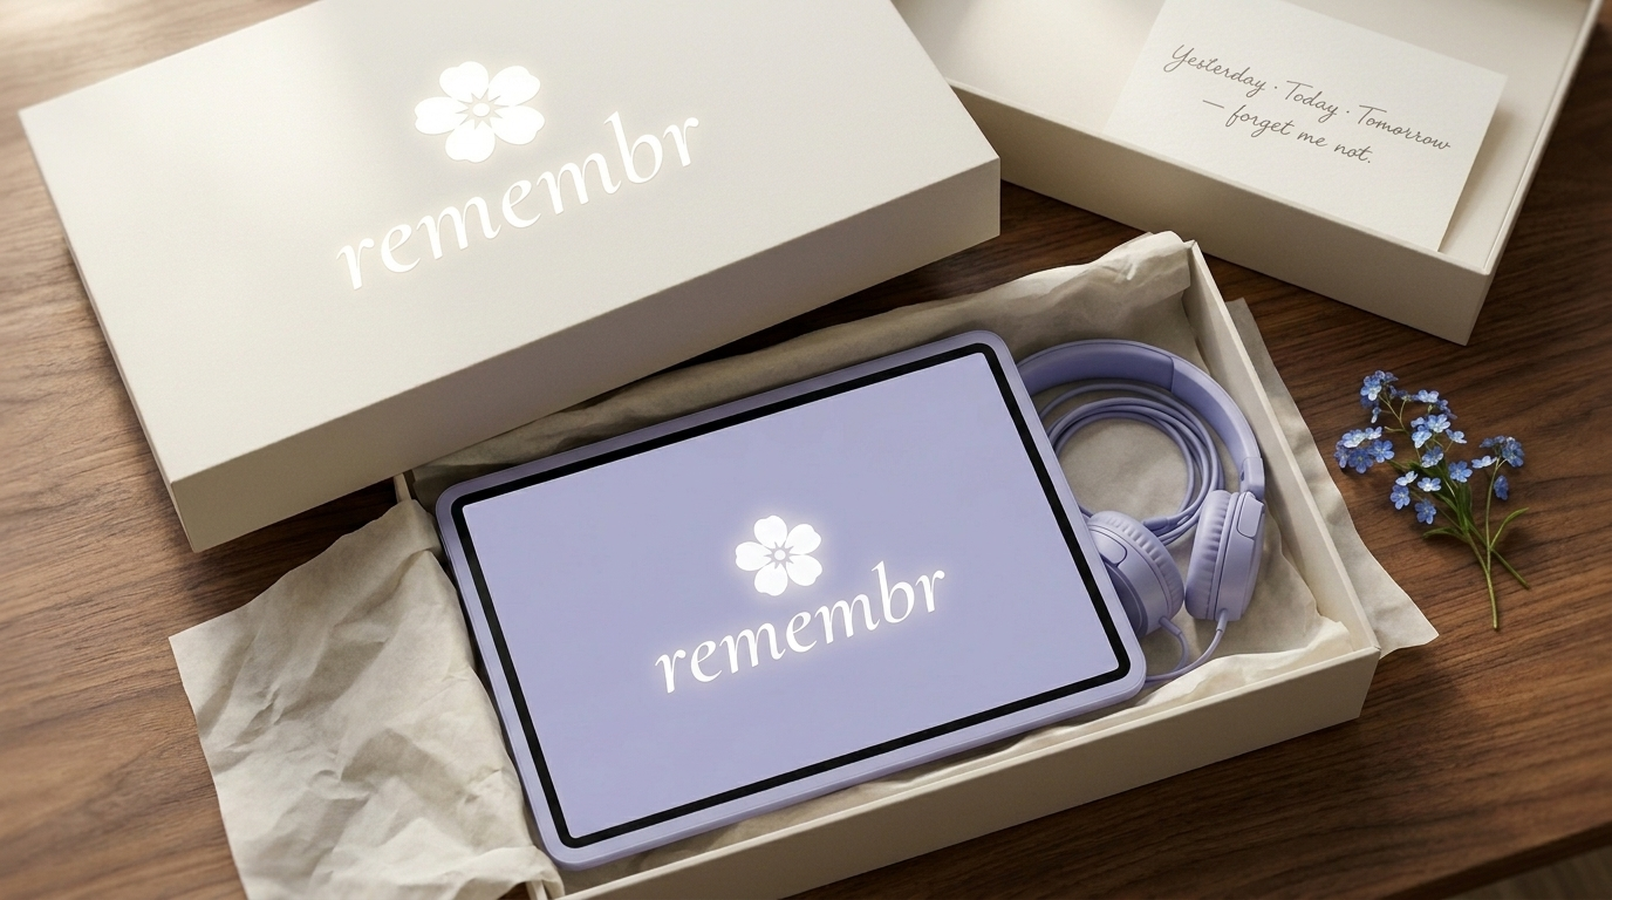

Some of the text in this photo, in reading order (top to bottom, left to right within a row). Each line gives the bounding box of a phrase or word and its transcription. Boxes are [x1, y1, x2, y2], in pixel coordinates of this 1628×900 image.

[1163, 44, 1267, 98] Yesterday
[1285, 80, 1338, 123] Today
[1358, 104, 1451, 150] Tomorrow
[1225, 104, 1295, 138] forget
[1297, 131, 1328, 148] me
[1334, 144, 1372, 163] not.
[336, 111, 700, 290] remembr
[655, 560, 945, 694] remembr
